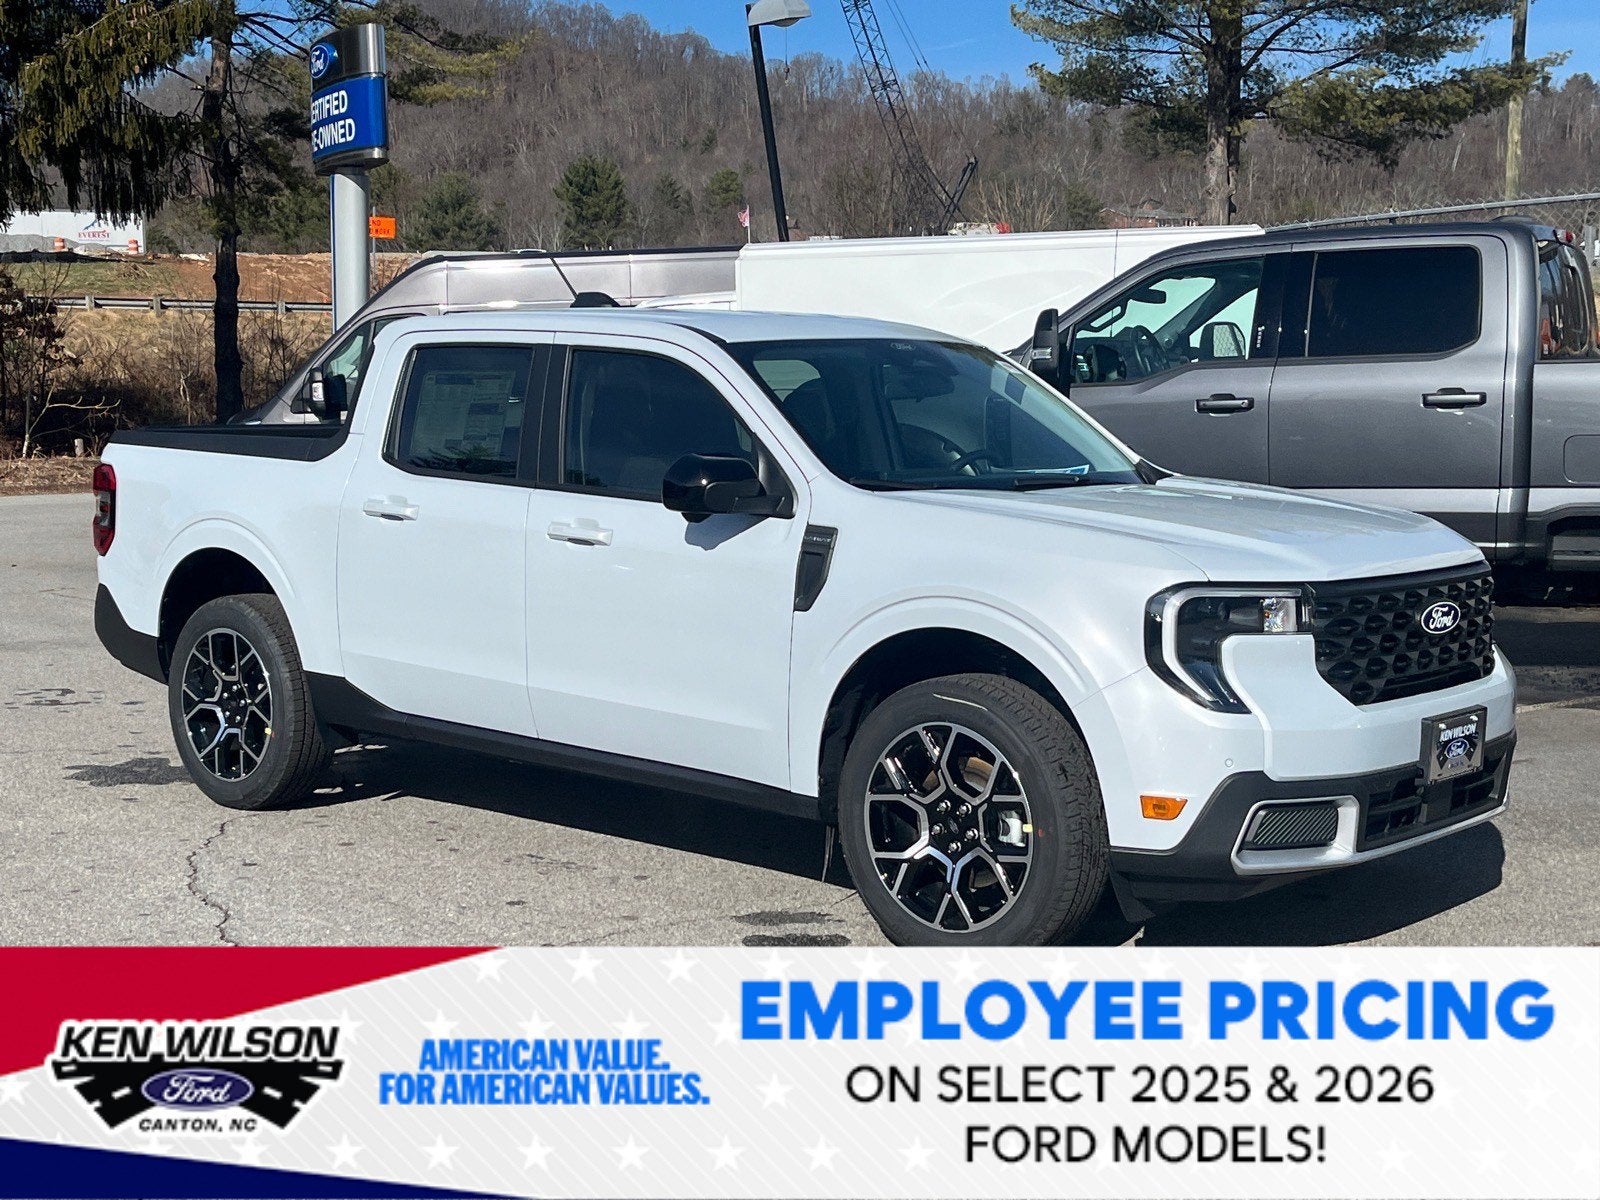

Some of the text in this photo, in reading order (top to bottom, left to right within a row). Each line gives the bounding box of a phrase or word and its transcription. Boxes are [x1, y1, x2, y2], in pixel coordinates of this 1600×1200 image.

[311, 50, 325, 74] Ford
[311, 90, 348, 125] ERTIFIED
[311, 118, 356, 152] E-OWNED
[1429, 606, 1455, 629] Ford
[1440, 723, 1477, 742] KEN WILSON
[1449, 741, 1465, 757] Ford
